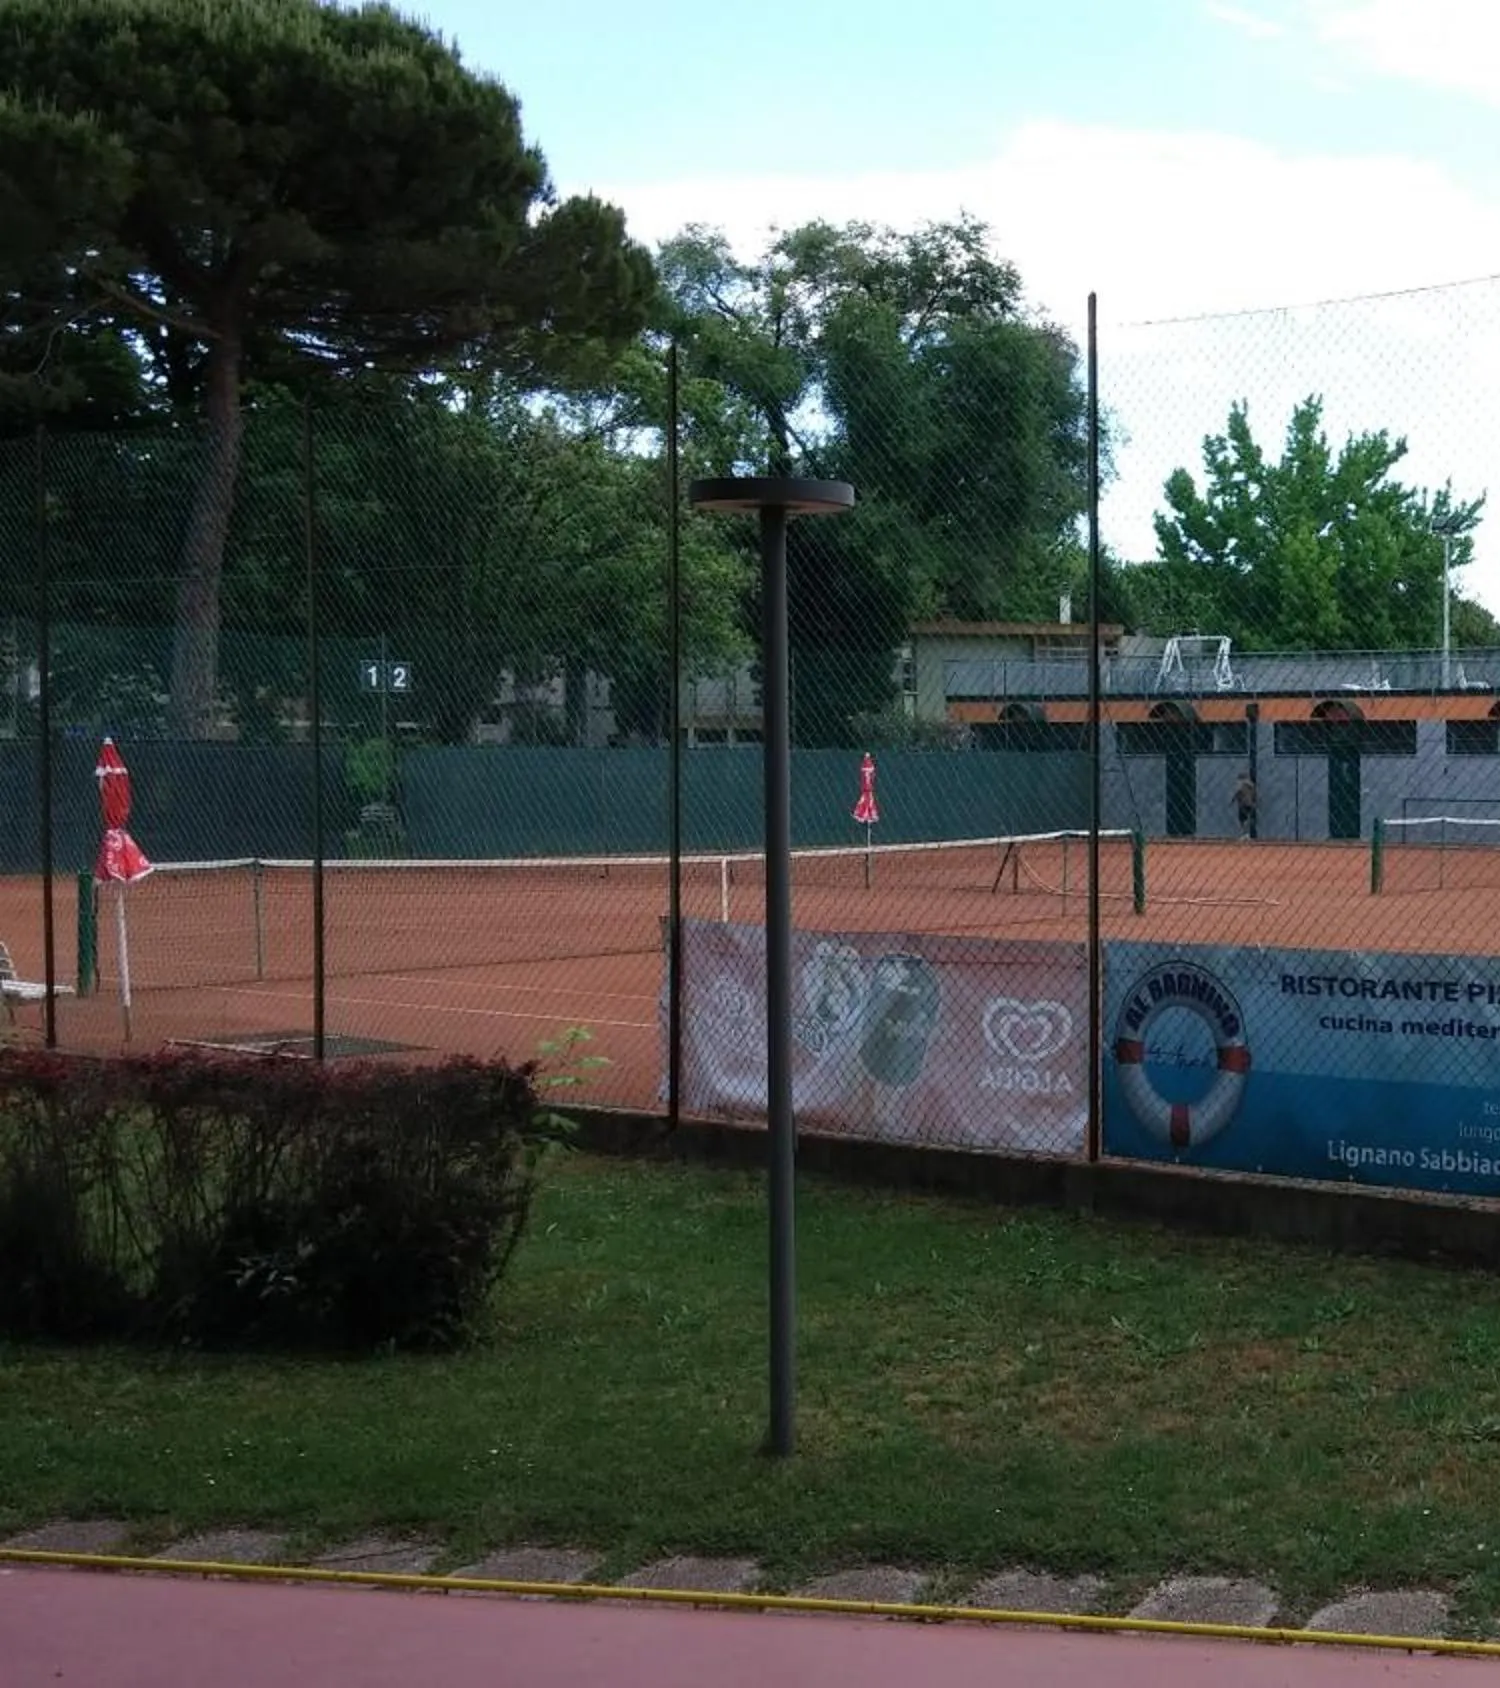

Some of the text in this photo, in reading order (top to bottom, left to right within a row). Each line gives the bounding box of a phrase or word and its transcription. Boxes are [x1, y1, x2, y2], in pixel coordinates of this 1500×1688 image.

[367, 665, 407, 688] 1 2
[1280, 974, 1459, 1003] RISTORANTE
[1319, 1013, 1393, 1034] cucina
[1327, 1139, 1415, 1168] Lignano
